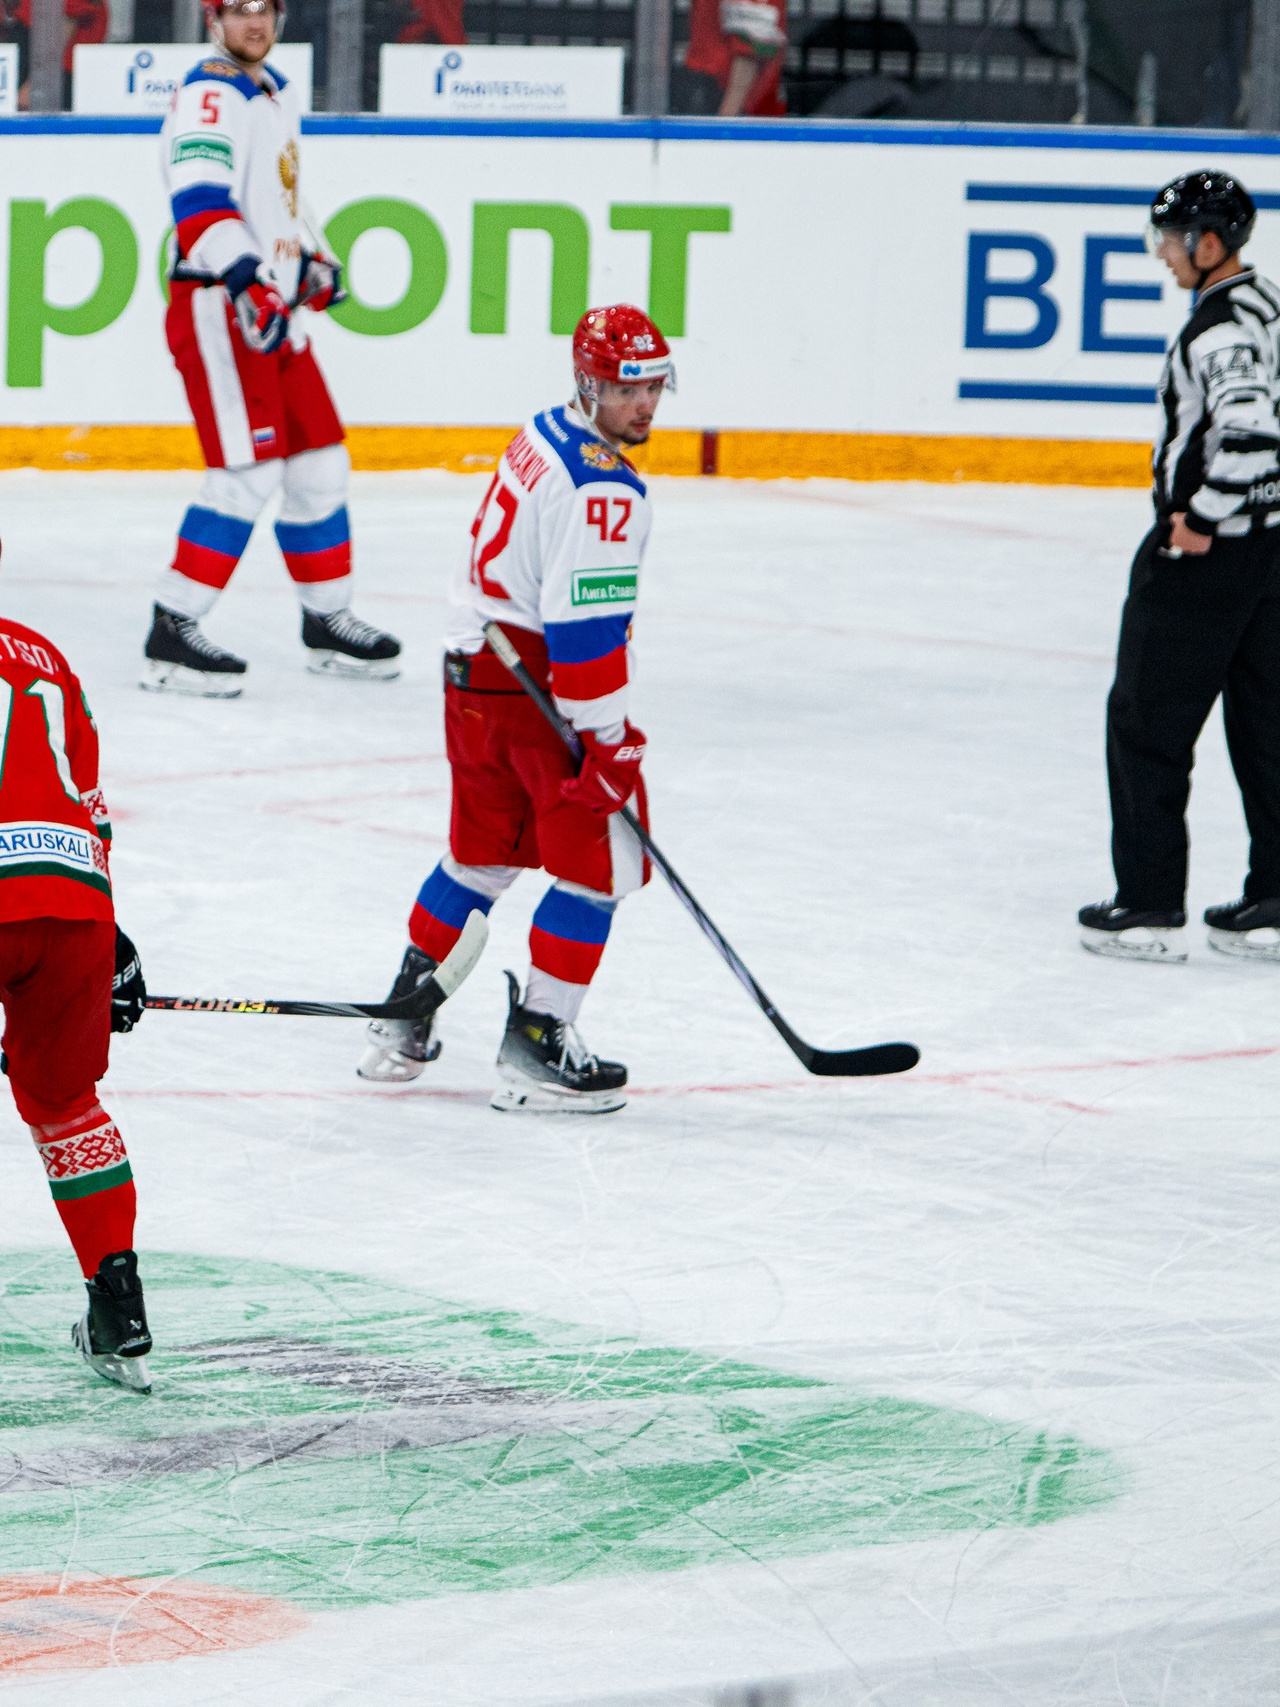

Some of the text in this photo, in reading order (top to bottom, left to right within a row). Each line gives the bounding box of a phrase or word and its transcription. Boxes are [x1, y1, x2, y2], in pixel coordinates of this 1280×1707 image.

[201, 91, 221, 124] 5
[964, 231, 1170, 355] BE
[586, 496, 633, 542] 92
